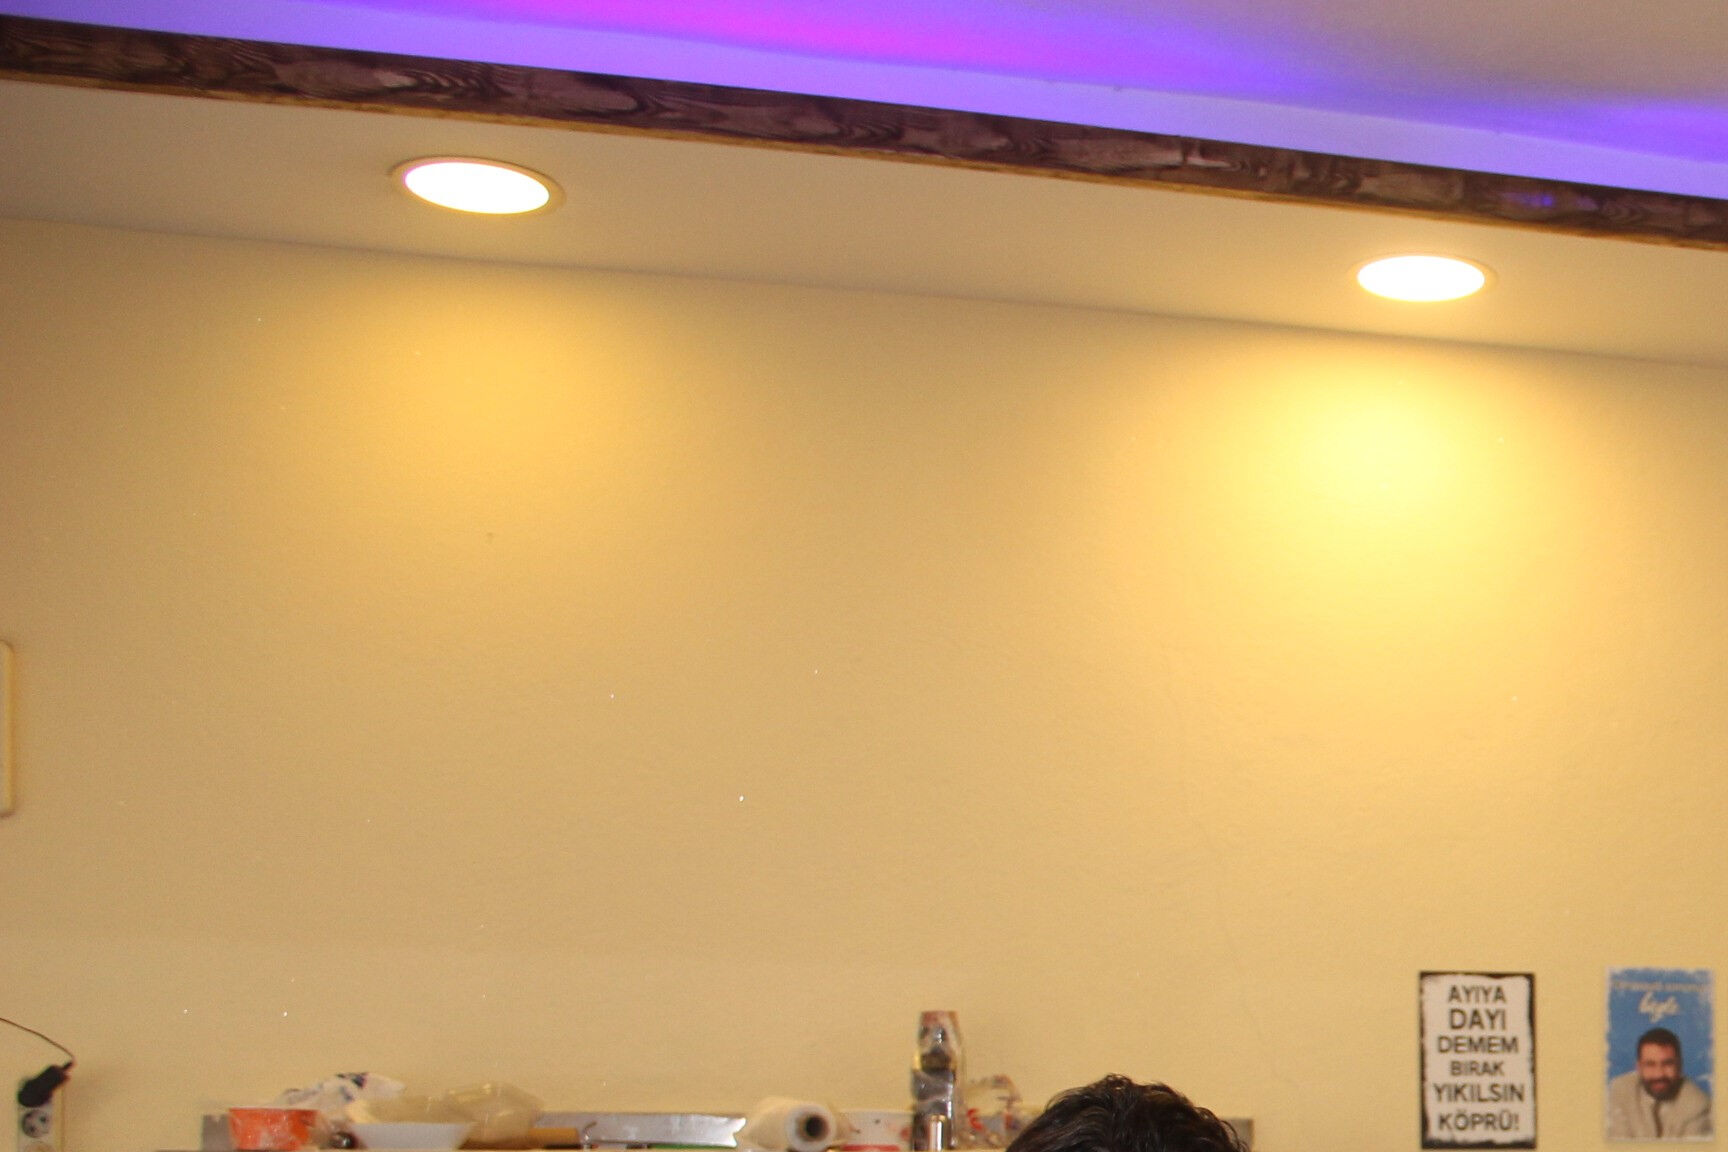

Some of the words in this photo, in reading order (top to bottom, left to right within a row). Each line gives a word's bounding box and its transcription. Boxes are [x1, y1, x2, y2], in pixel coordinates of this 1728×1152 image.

[1449, 984, 1506, 1002] AYIYA
[1450, 1008, 1506, 1030] DAYI
[1438, 1036, 1519, 1053] DEMEM
[1451, 1061, 1505, 1077] BIRAK
[1433, 1083, 1525, 1102] YIKILSIN
[1439, 1110, 1520, 1131] KÖPRÜ!
